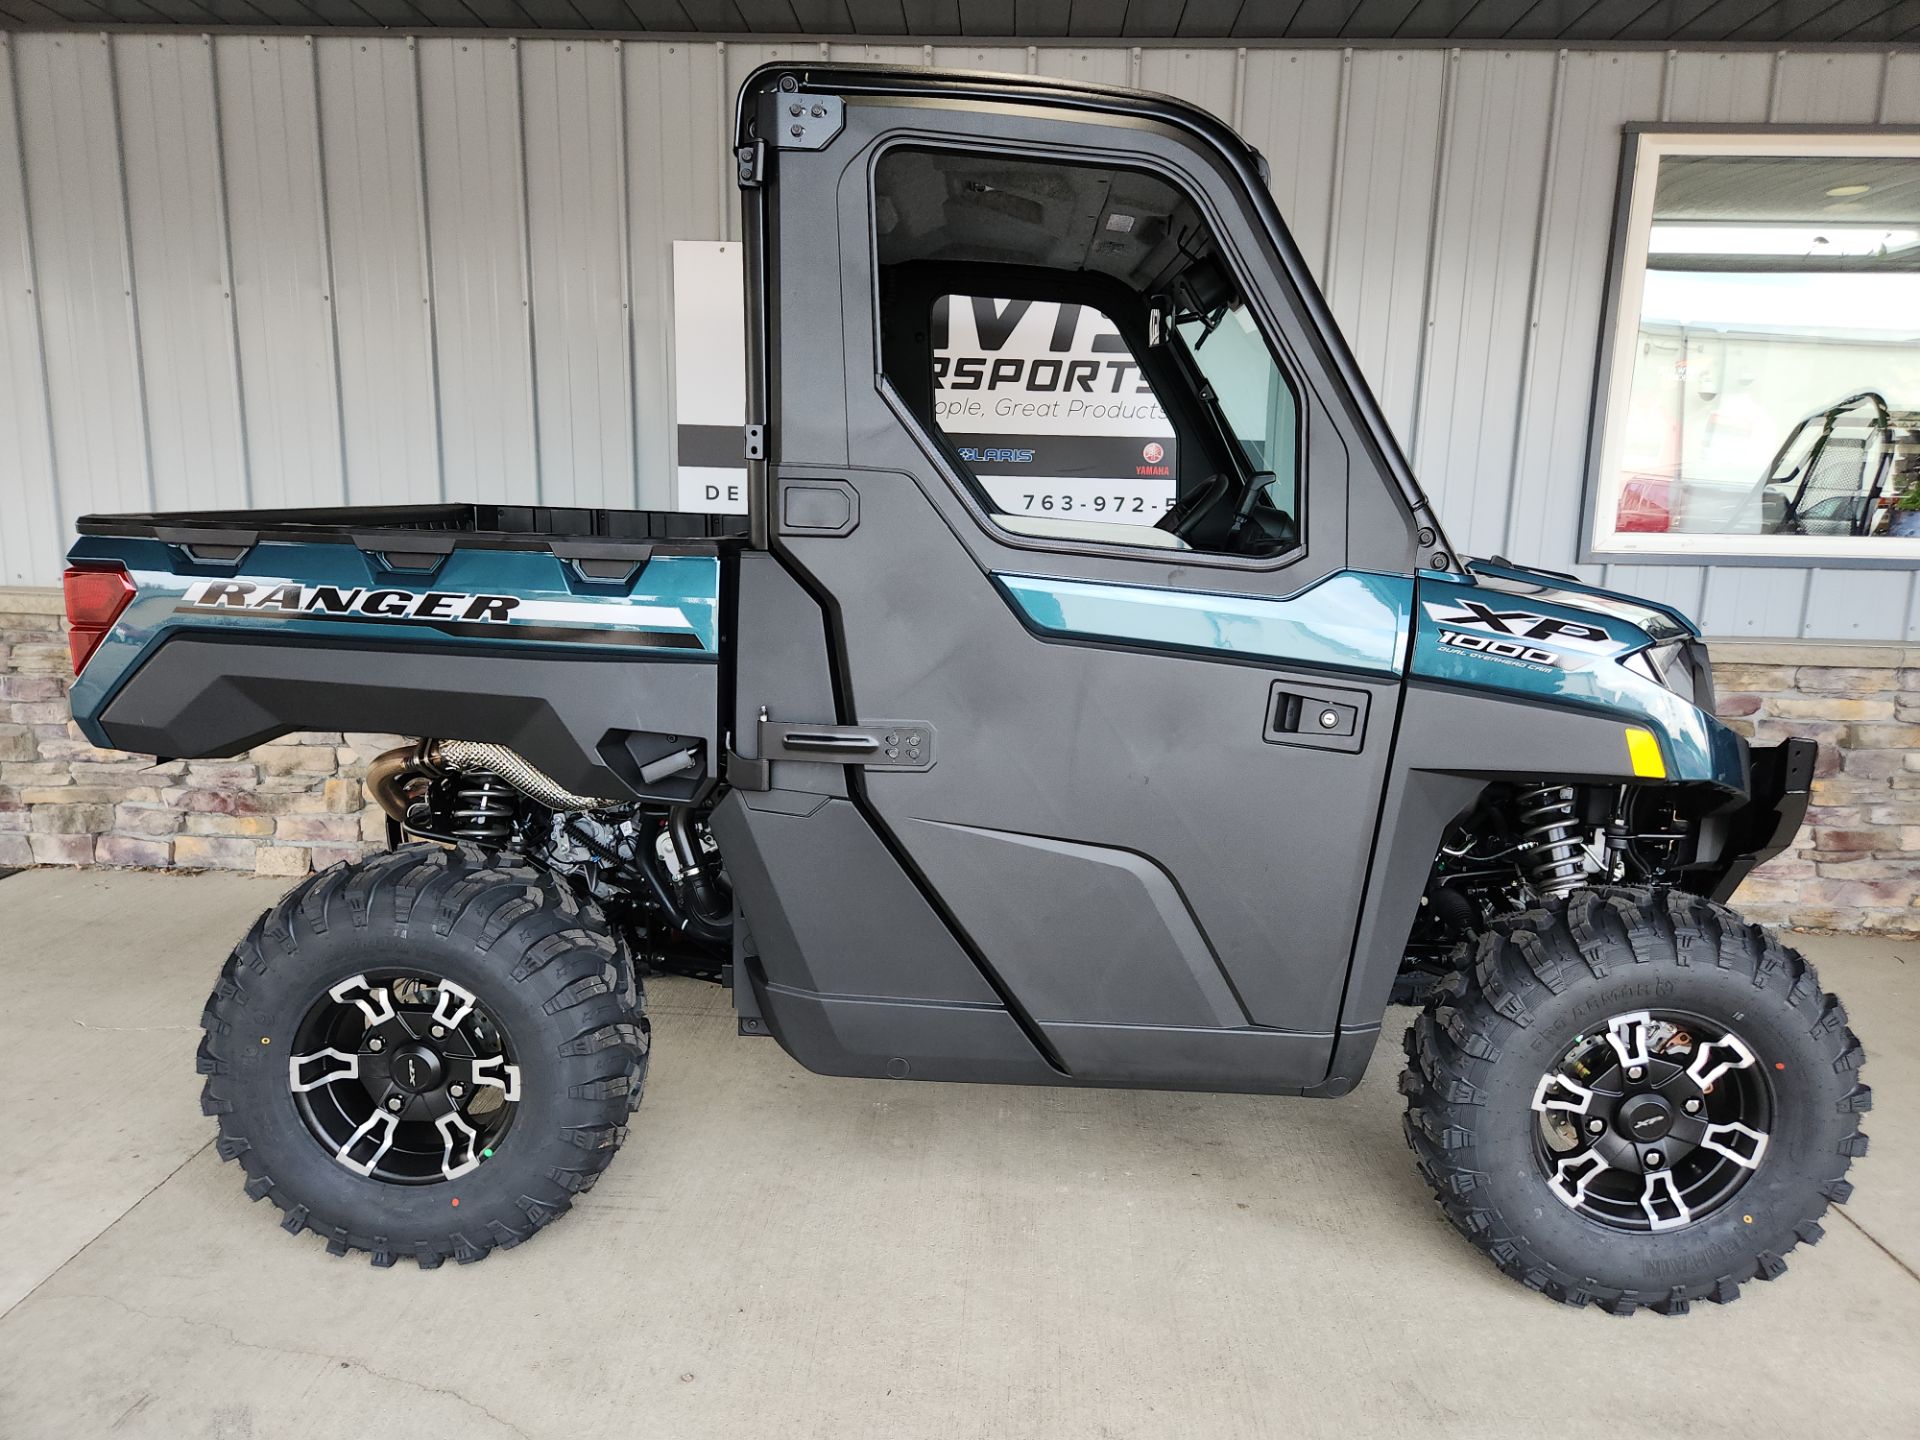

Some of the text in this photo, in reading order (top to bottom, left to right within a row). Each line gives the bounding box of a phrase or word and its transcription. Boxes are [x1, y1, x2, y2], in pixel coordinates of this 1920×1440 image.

[995, 398, 1060, 418] Great
[1136, 465, 1169, 476] YAMAHA
[194, 580, 521, 623] RANGER
[1436, 599, 1612, 643] XP
[1437, 646, 1554, 674] DUAL OVERHEAD CAM
[1438, 629, 1560, 666] 1000
